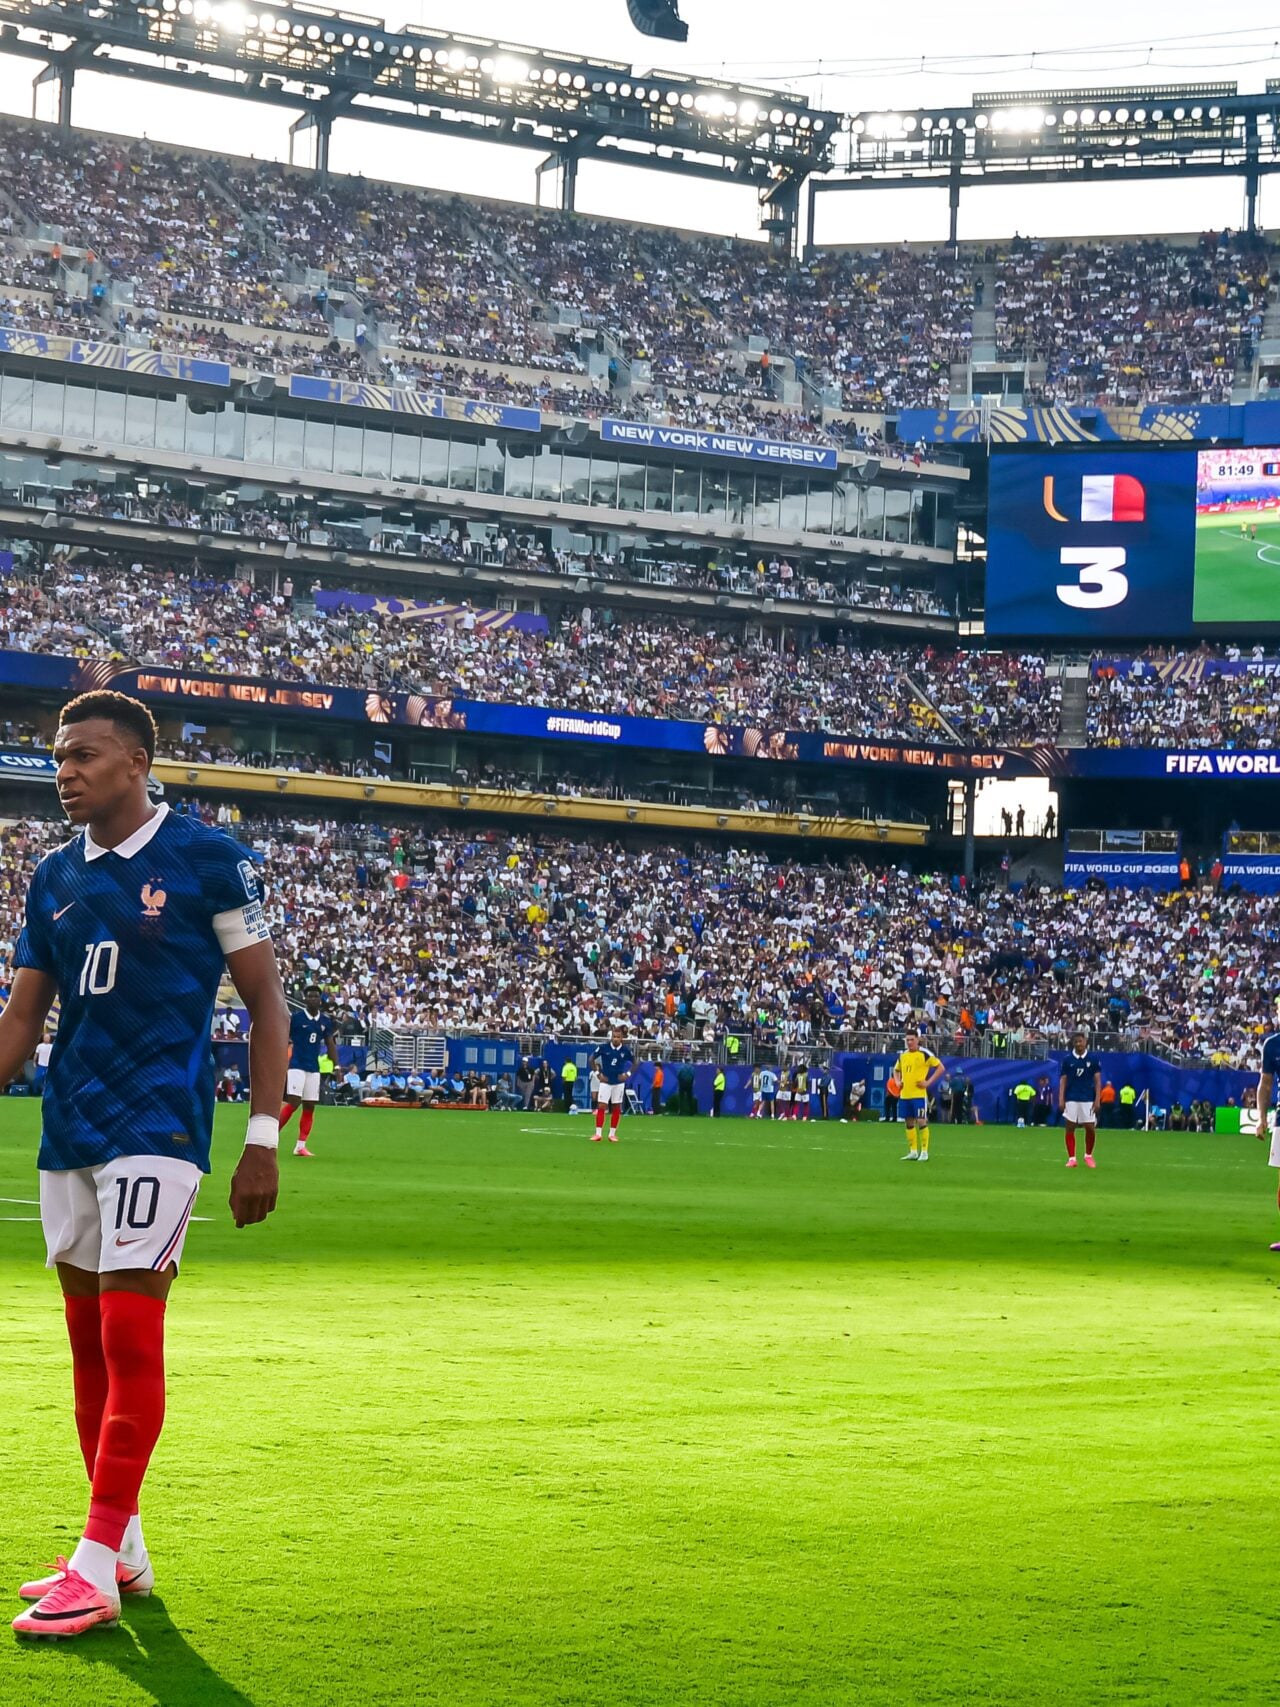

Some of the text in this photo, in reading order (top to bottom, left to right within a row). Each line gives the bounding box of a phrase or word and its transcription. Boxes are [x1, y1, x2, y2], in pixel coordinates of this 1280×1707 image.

[611, 424, 826, 463] NEW YORK NEW JERSEY
[1218, 465, 1254, 476] 81:49
[1056, 546, 1129, 609] 3
[137, 674, 176, 694] NEW
[229, 684, 267, 703] NEW
[270, 689, 333, 710] JESEY
[547, 716, 621, 739] #FIFAWorldCup
[0, 755, 47, 768] CUP
[902, 749, 934, 766] NEW
[937, 753, 1004, 769] JESEY
[1166, 755, 1213, 773] FIFA
[1064, 864, 1178, 874] FIFA WORLD CUP 2026
[1223, 866, 1244, 874] FIFA
[79, 940, 119, 996] 10
[309, 1032, 317, 1043] 8
[1076, 1068, 1085, 1077] 17
[115, 1176, 161, 1230] 10
